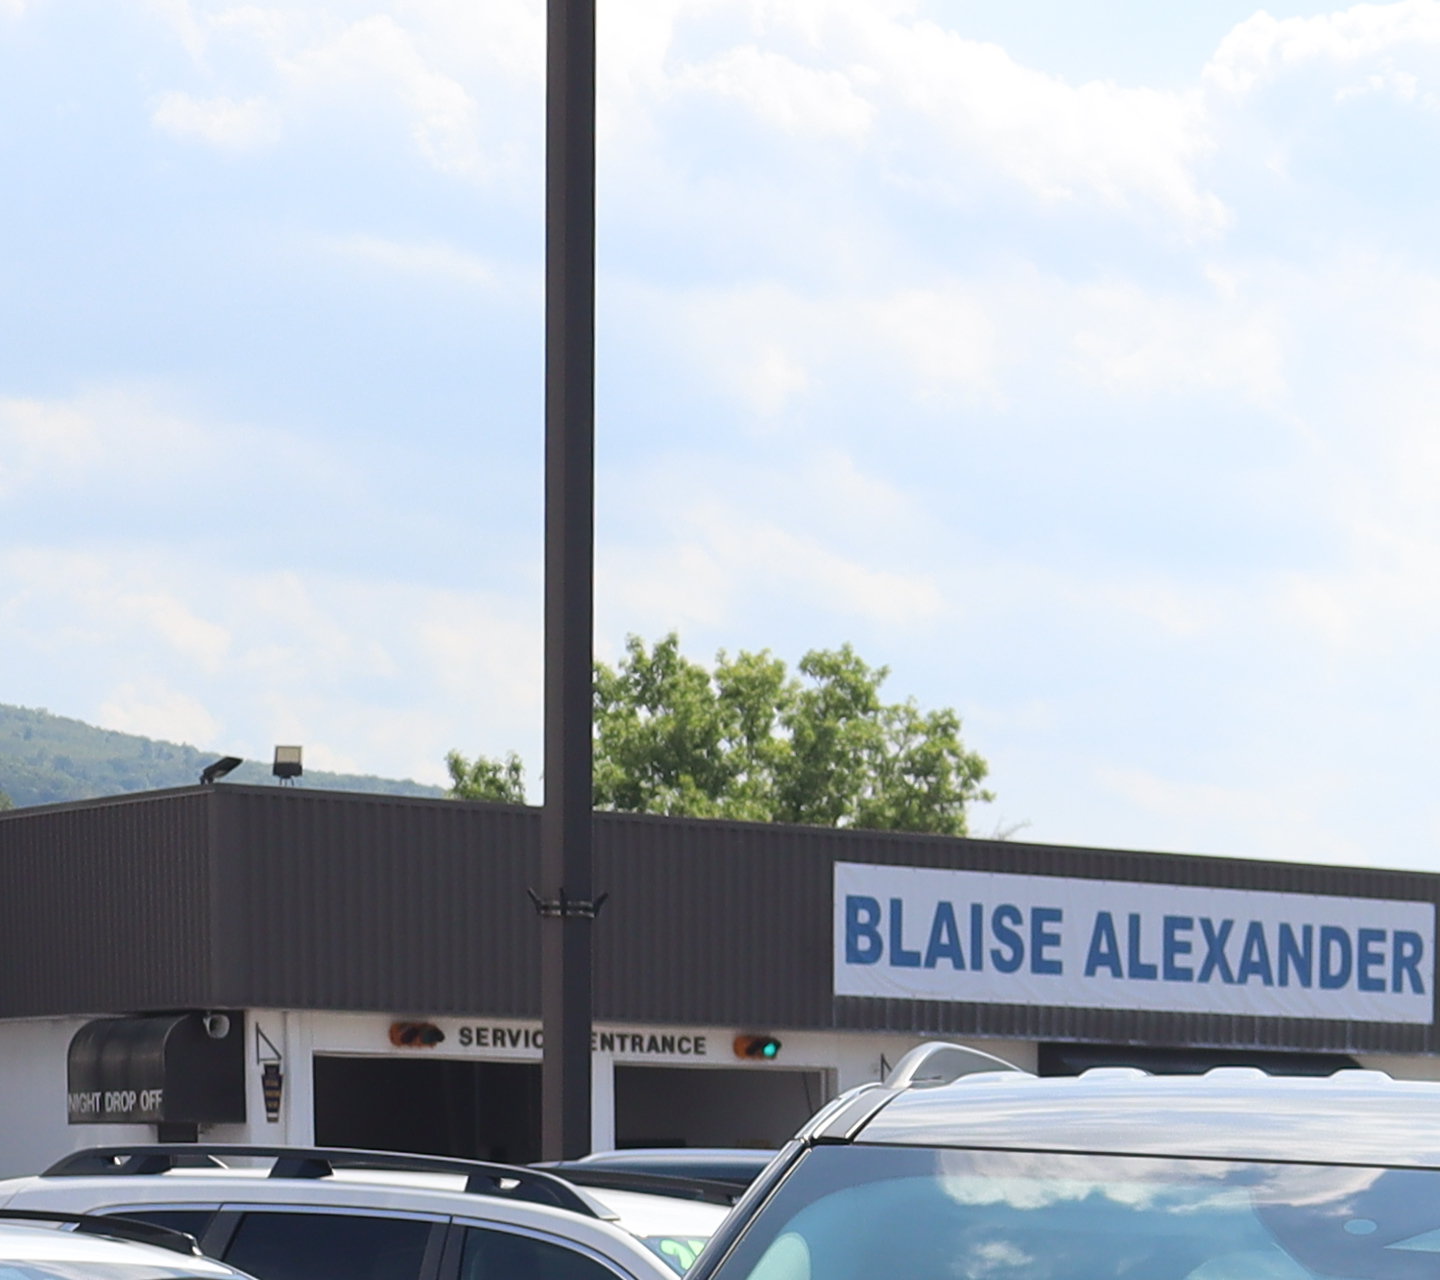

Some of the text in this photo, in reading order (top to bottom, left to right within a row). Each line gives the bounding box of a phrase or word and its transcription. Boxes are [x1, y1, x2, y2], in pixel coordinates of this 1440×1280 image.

[844, 894, 1425, 996] BLAISE ALEXANDER
[459, 1026, 543, 1049] SERVIC
[67, 1089, 163, 1113] NIGHT DROP OFF
